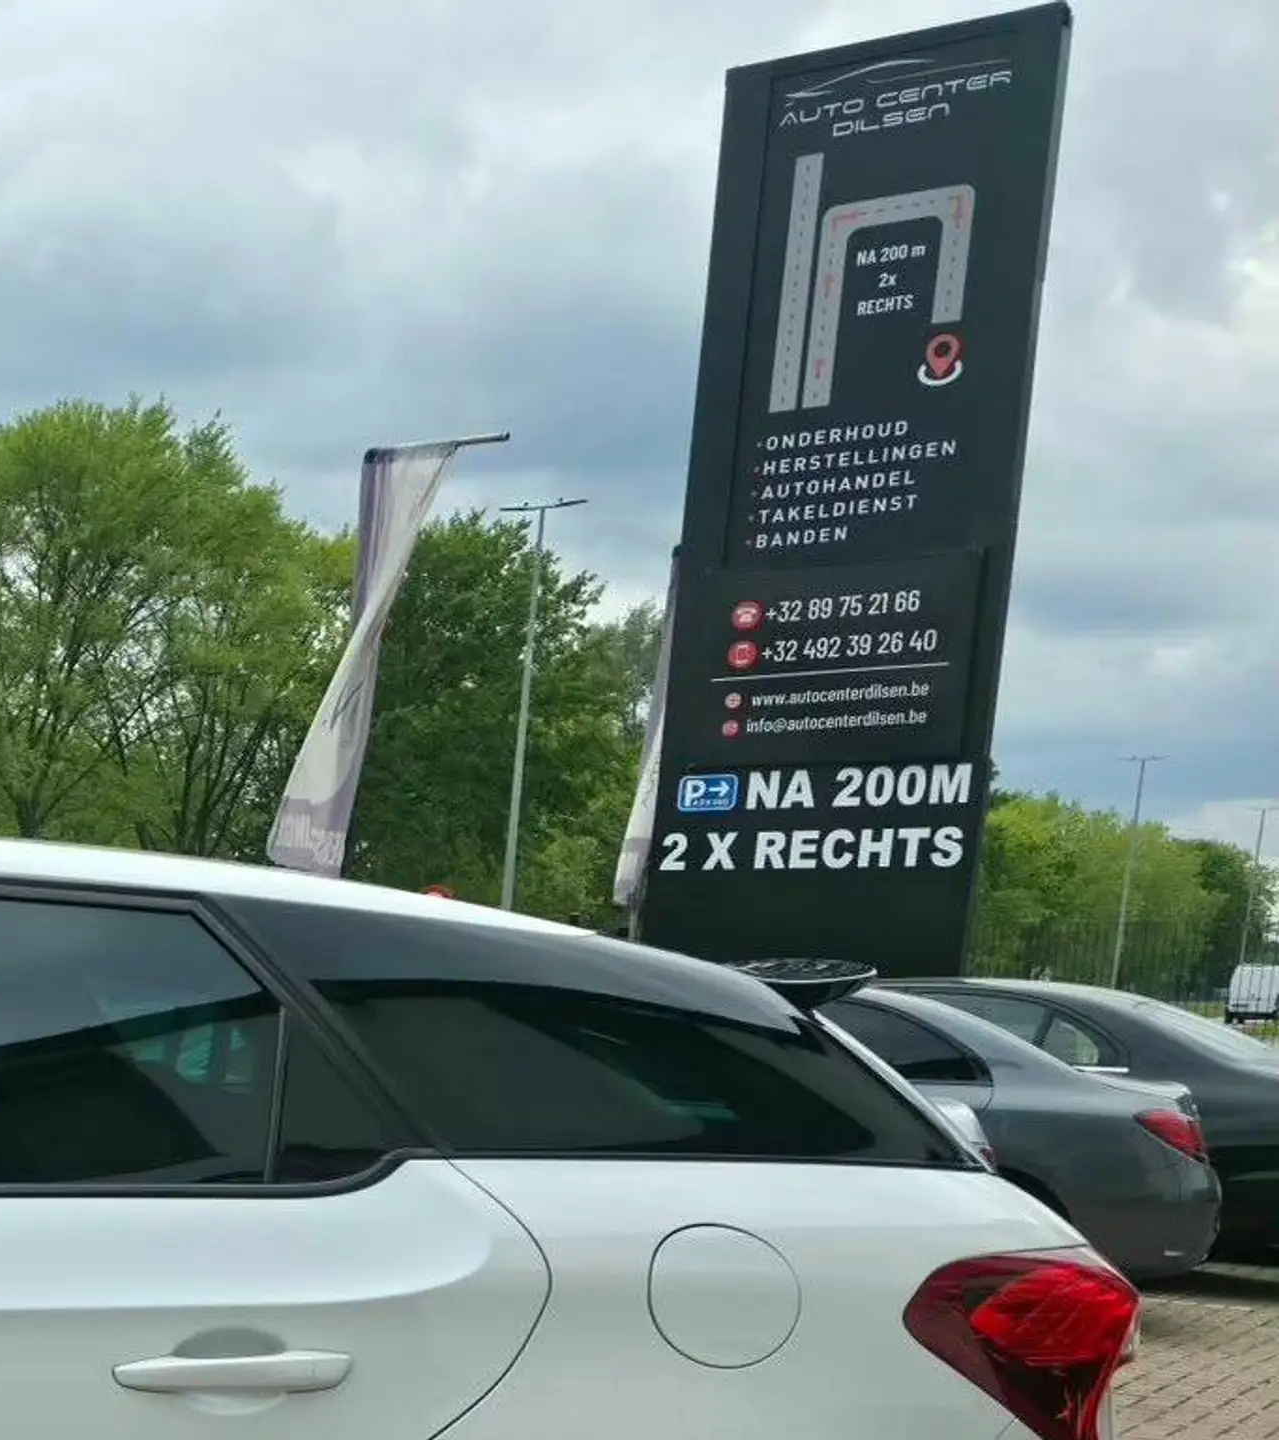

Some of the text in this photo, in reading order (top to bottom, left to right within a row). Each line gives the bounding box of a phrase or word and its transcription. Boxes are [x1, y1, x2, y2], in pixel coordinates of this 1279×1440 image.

[779, 70, 1012, 127] AUTO CENTER
[833, 102, 951, 137] DILSEN
[856, 243, 926, 267] NA 200 m
[878, 272, 897, 288] 2x
[856, 293, 914, 316] RECHTS
[765, 420, 909, 451] ONDERHOUD
[762, 439, 957, 476] HERSTELLINGEN
[760, 469, 916, 500] AUTOHANDEL
[758, 494, 918, 525] TAKELDIENST
[755, 526, 849, 549] BANDEN
[765, 589, 921, 622] +32 89 75 21 66
[762, 628, 938, 662] +32 492 39 26 40
[751, 680, 930, 707] www.autocenterdilsen.be
[746, 708, 928, 733] info@autocenterdilsen.be
[746, 770, 815, 810] NA
[832, 763, 973, 808] 200M
[659, 832, 689, 871] 2
[702, 831, 739, 871] X
[753, 826, 964, 870] RECHTS
